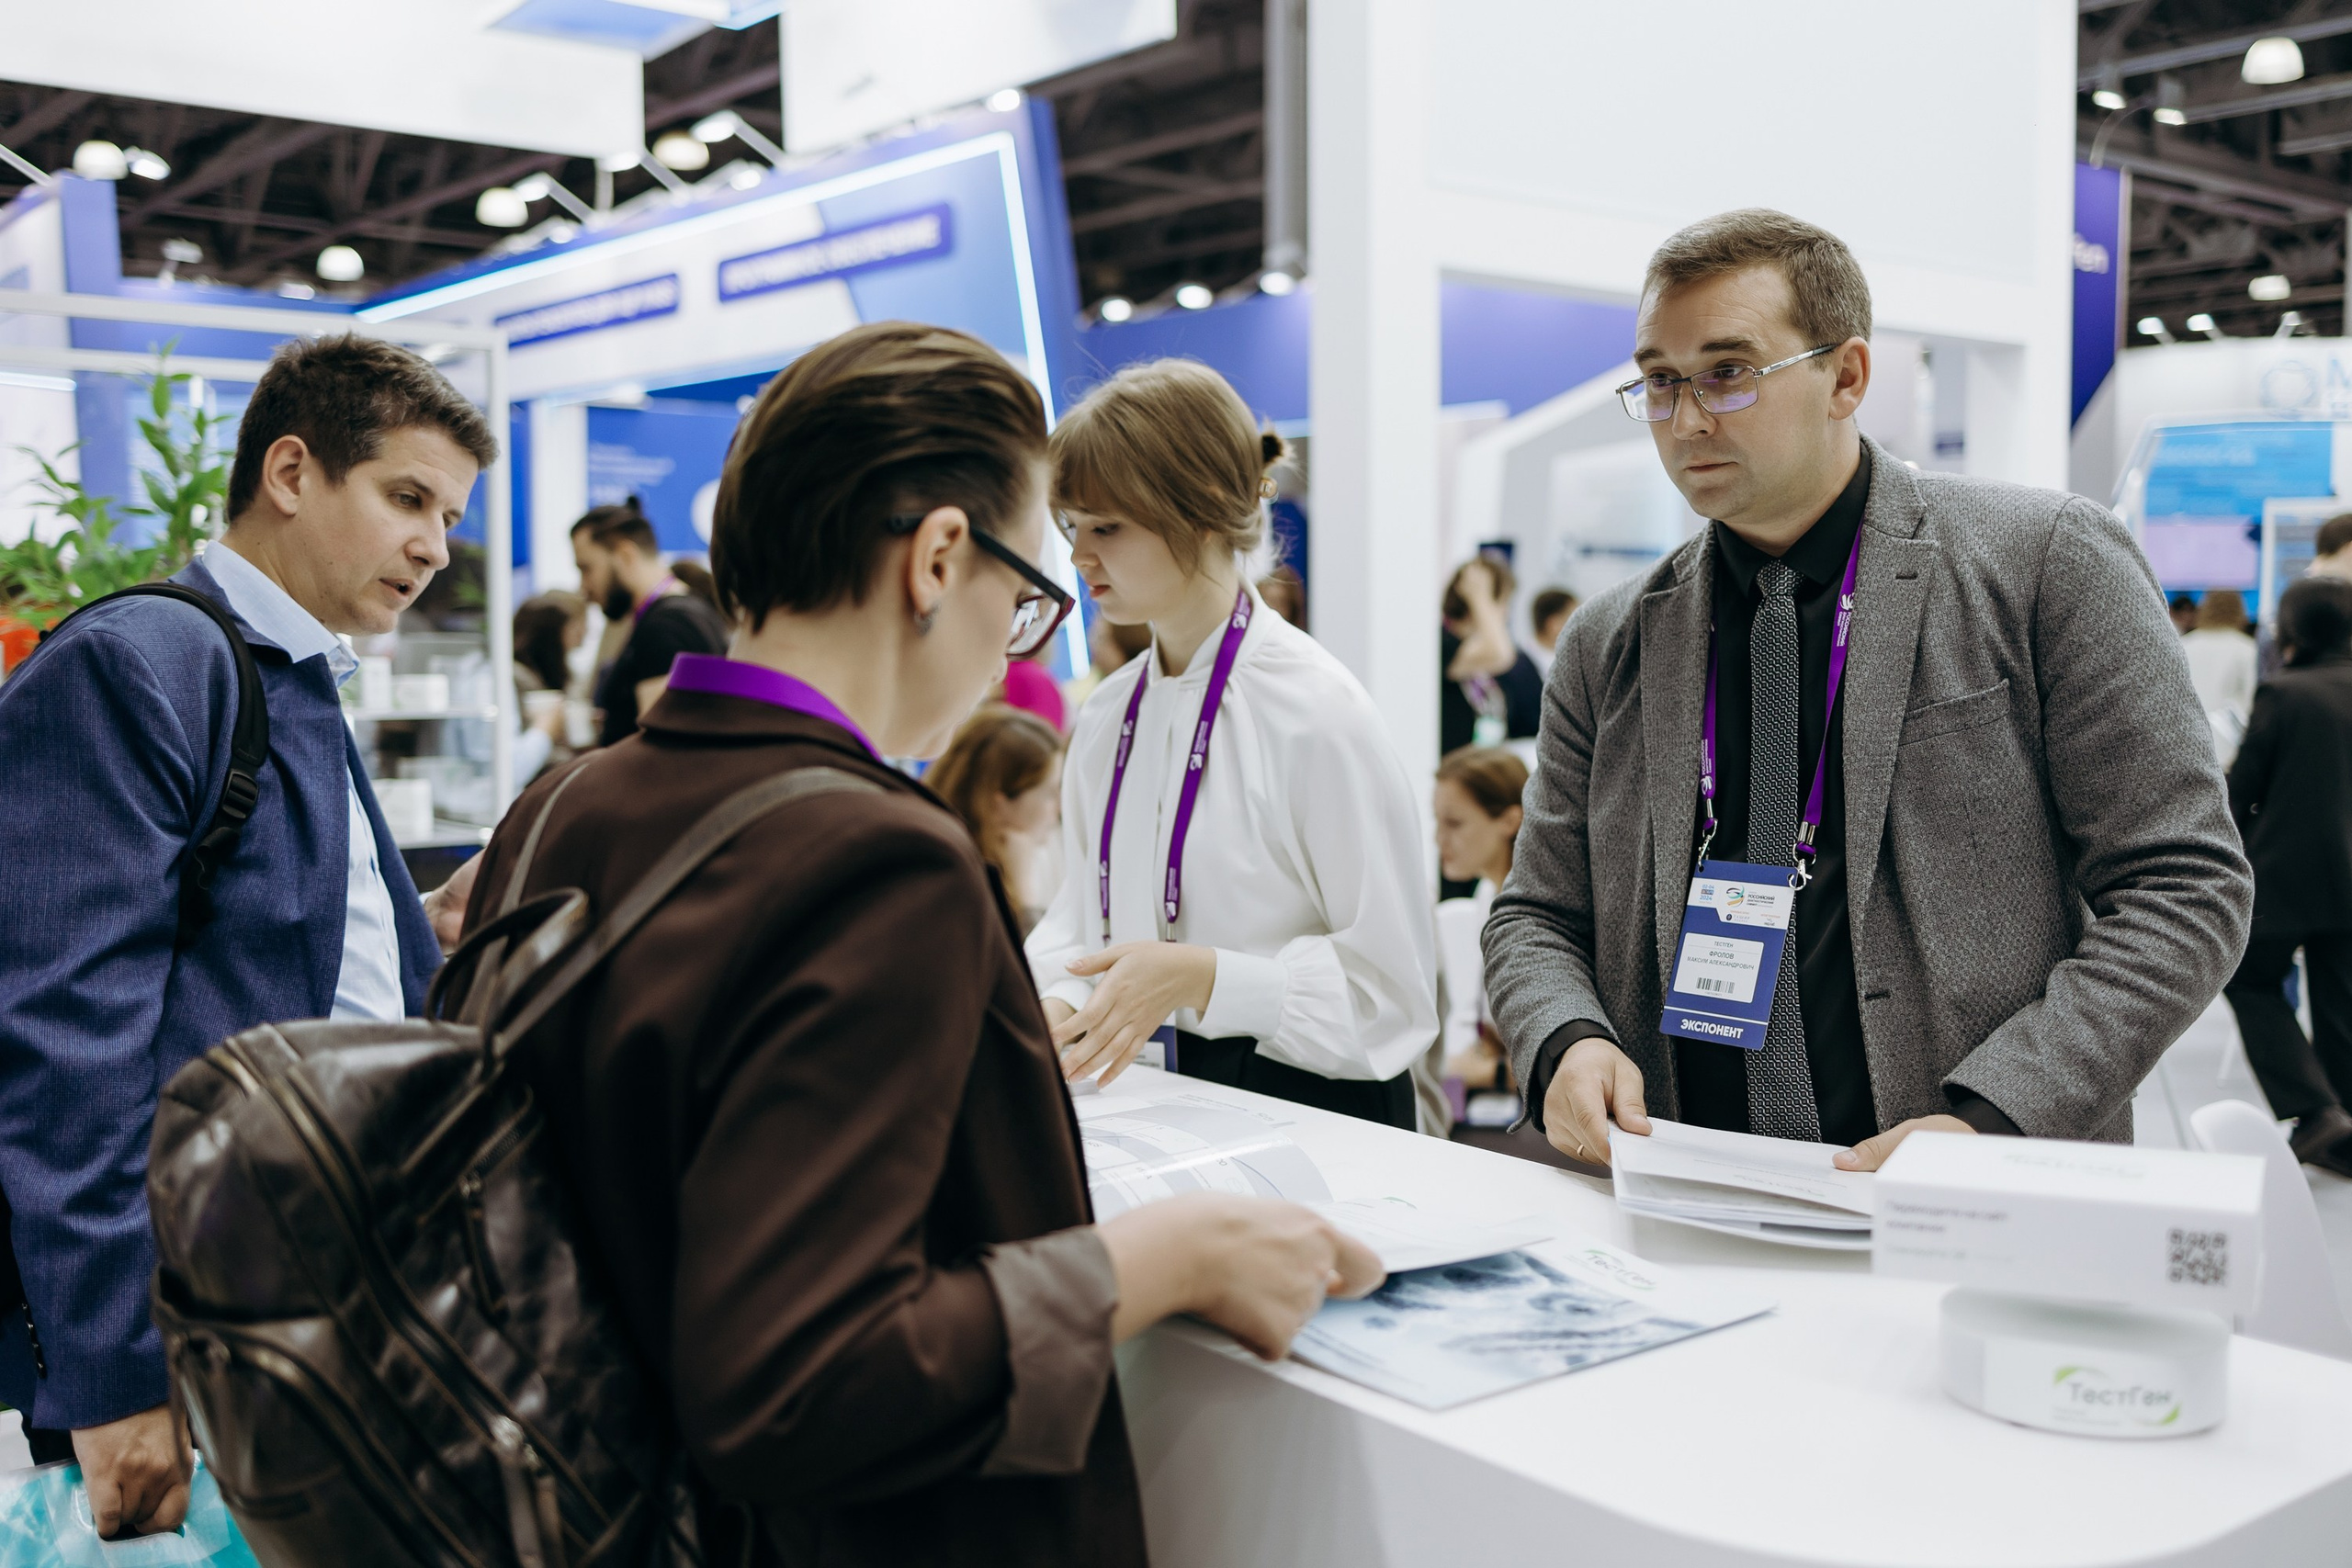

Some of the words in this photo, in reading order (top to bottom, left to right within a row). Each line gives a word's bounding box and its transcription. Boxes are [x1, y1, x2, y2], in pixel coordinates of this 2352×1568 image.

[1709, 951, 1735, 960] ФРОЛОВ
[1709, 959, 1755, 970] АЛЕКСАНДРОВИЧ
[1680, 1018, 1744, 1039] ЭКСПОНЕНТ
[2069, 1382, 2173, 1406] ТестГен
